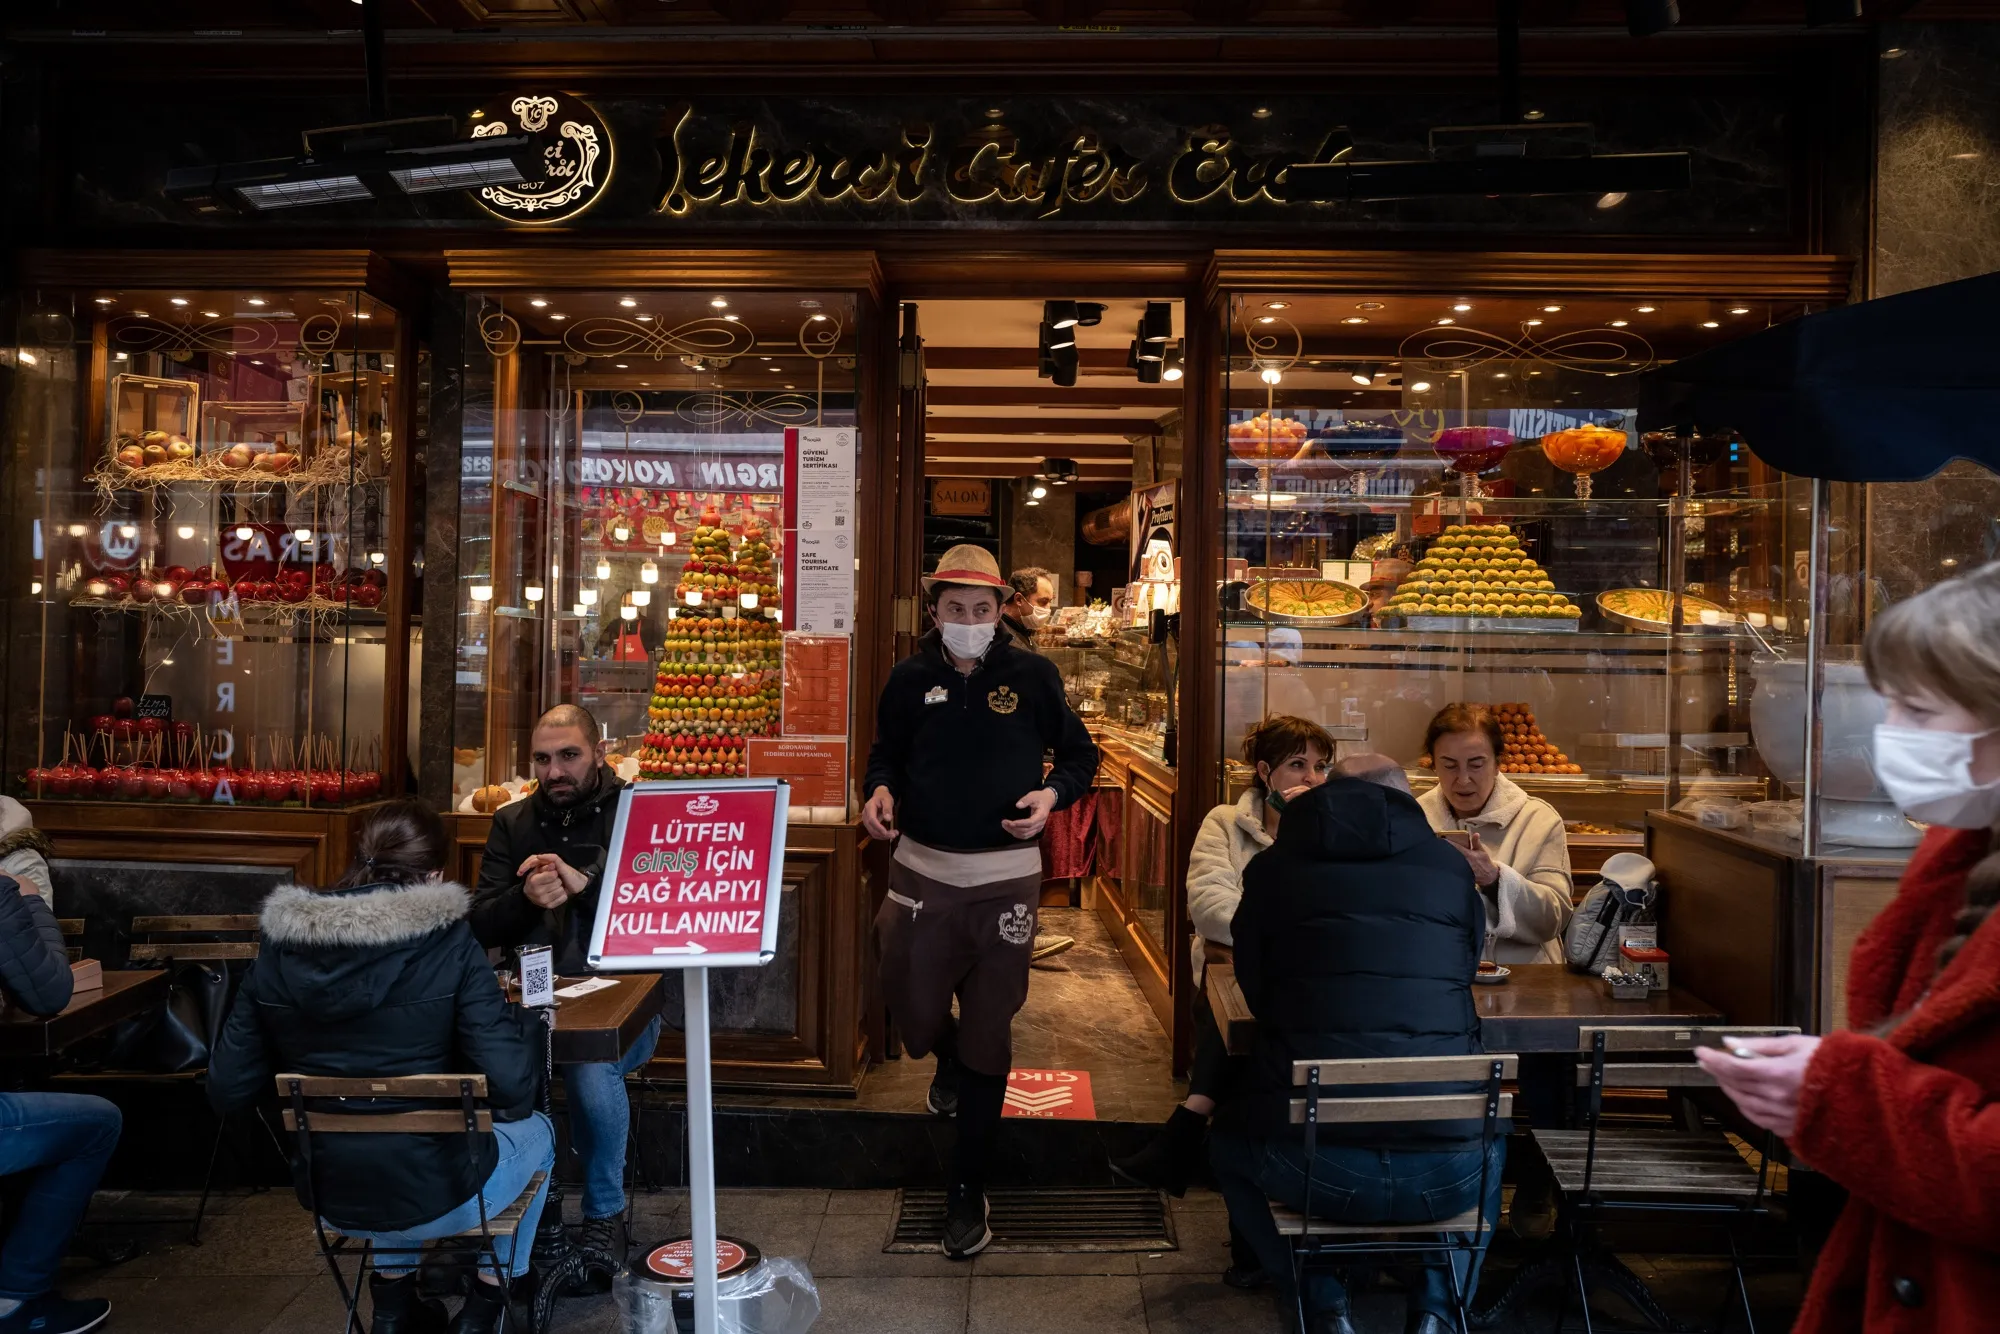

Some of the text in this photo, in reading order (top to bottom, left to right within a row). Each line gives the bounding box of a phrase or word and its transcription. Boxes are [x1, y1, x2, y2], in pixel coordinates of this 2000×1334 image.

[936, 490, 979, 504] SALON
[650, 819, 745, 844] LÜTFEN
[632, 845, 755, 878] GİRİŞ İÇİN
[617, 876, 762, 904] SAĞ KAPIYI
[608, 910, 761, 936] KULLANINIZ
[1009, 1071, 1079, 1083] ÇIKI
